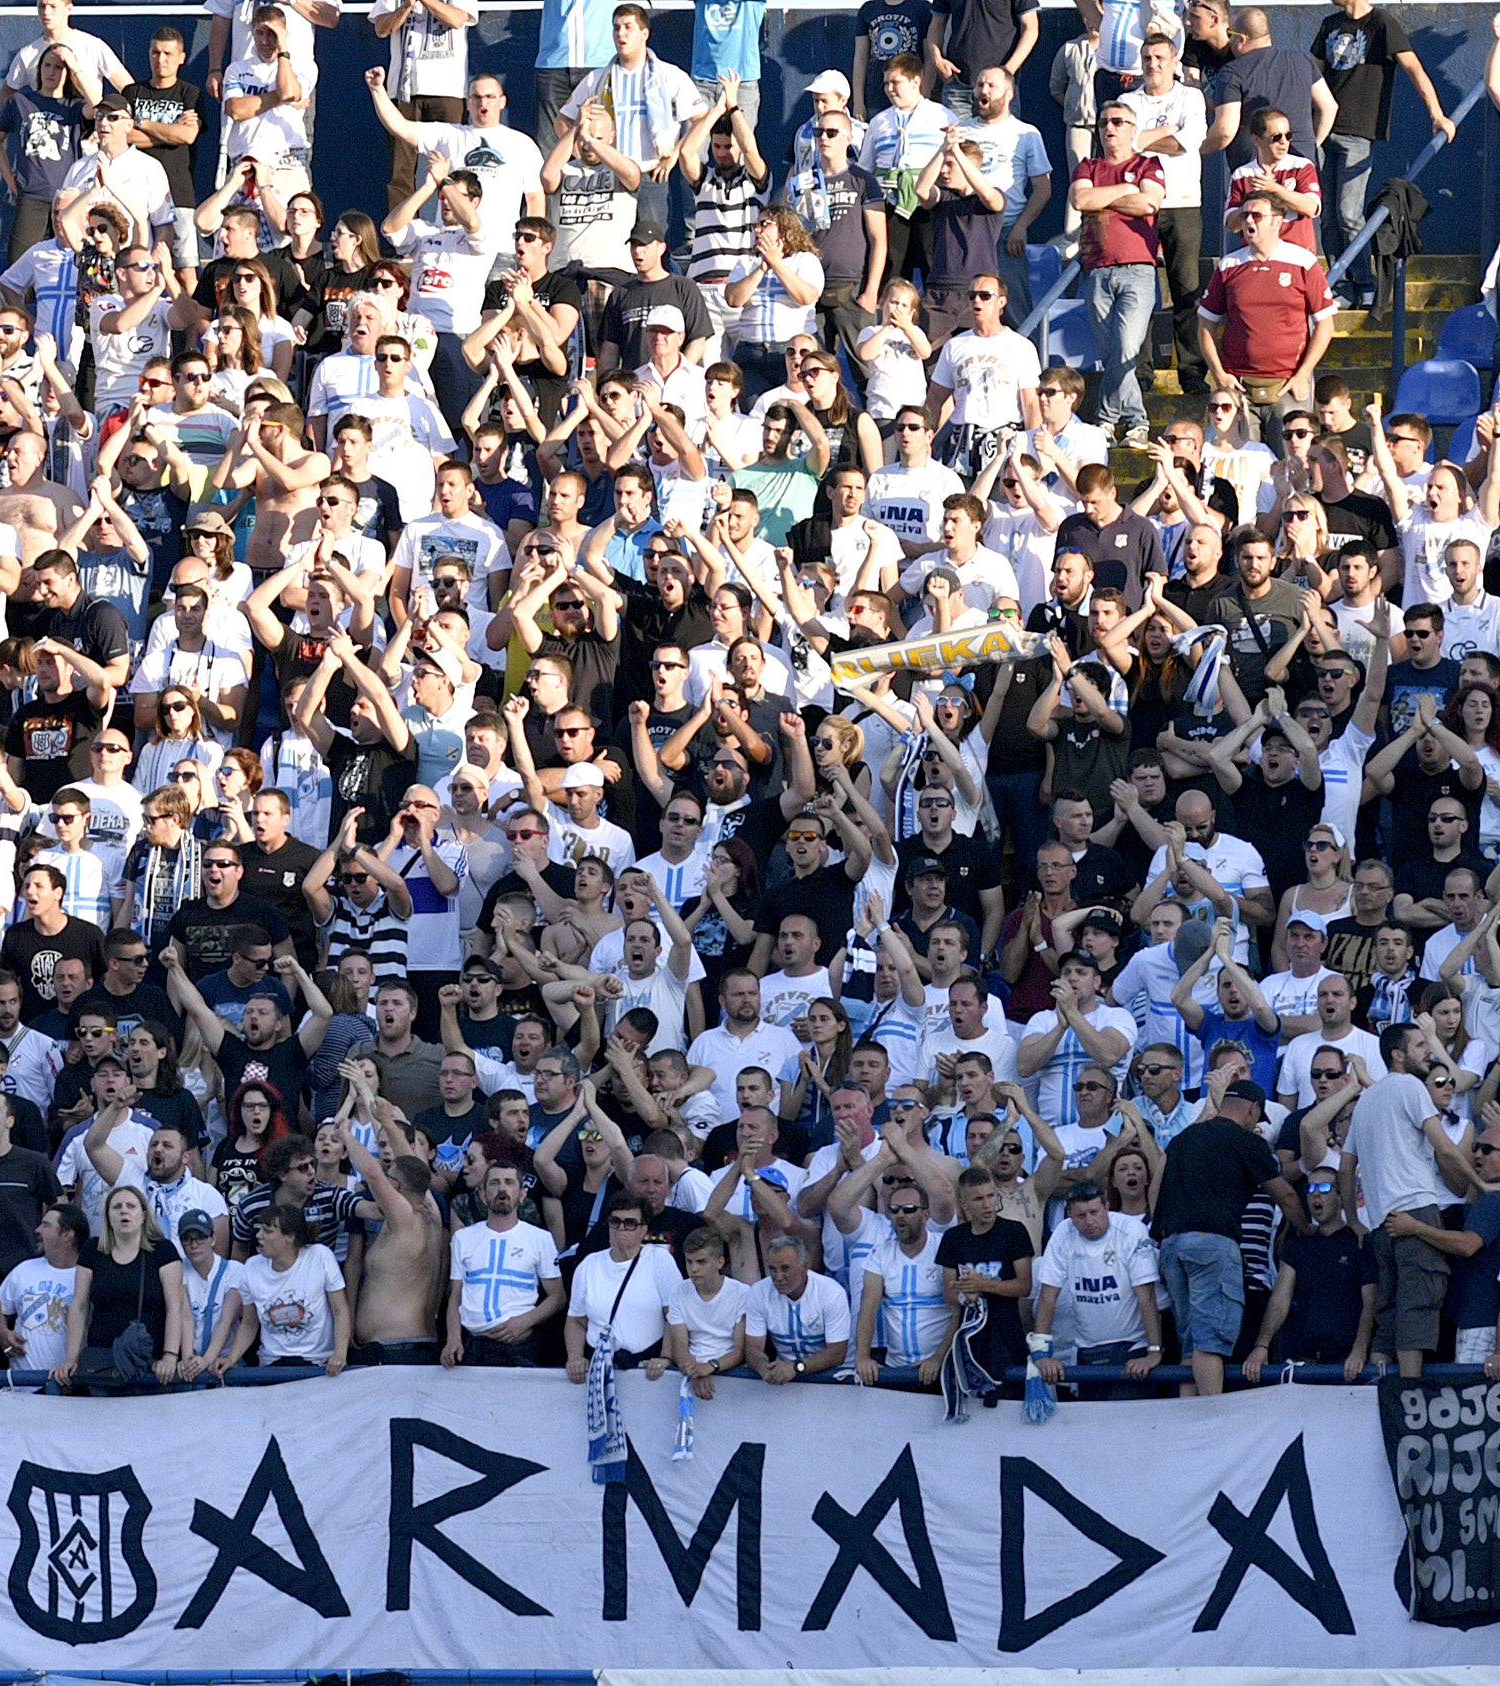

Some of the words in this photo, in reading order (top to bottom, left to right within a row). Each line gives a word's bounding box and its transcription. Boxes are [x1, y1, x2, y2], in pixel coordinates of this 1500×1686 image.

[879, 506, 924, 522] INA
[1075, 1275, 1118, 1293] INA
[1076, 1292, 1121, 1305] maziva
[174, 1418, 1356, 1652] ARMADA
